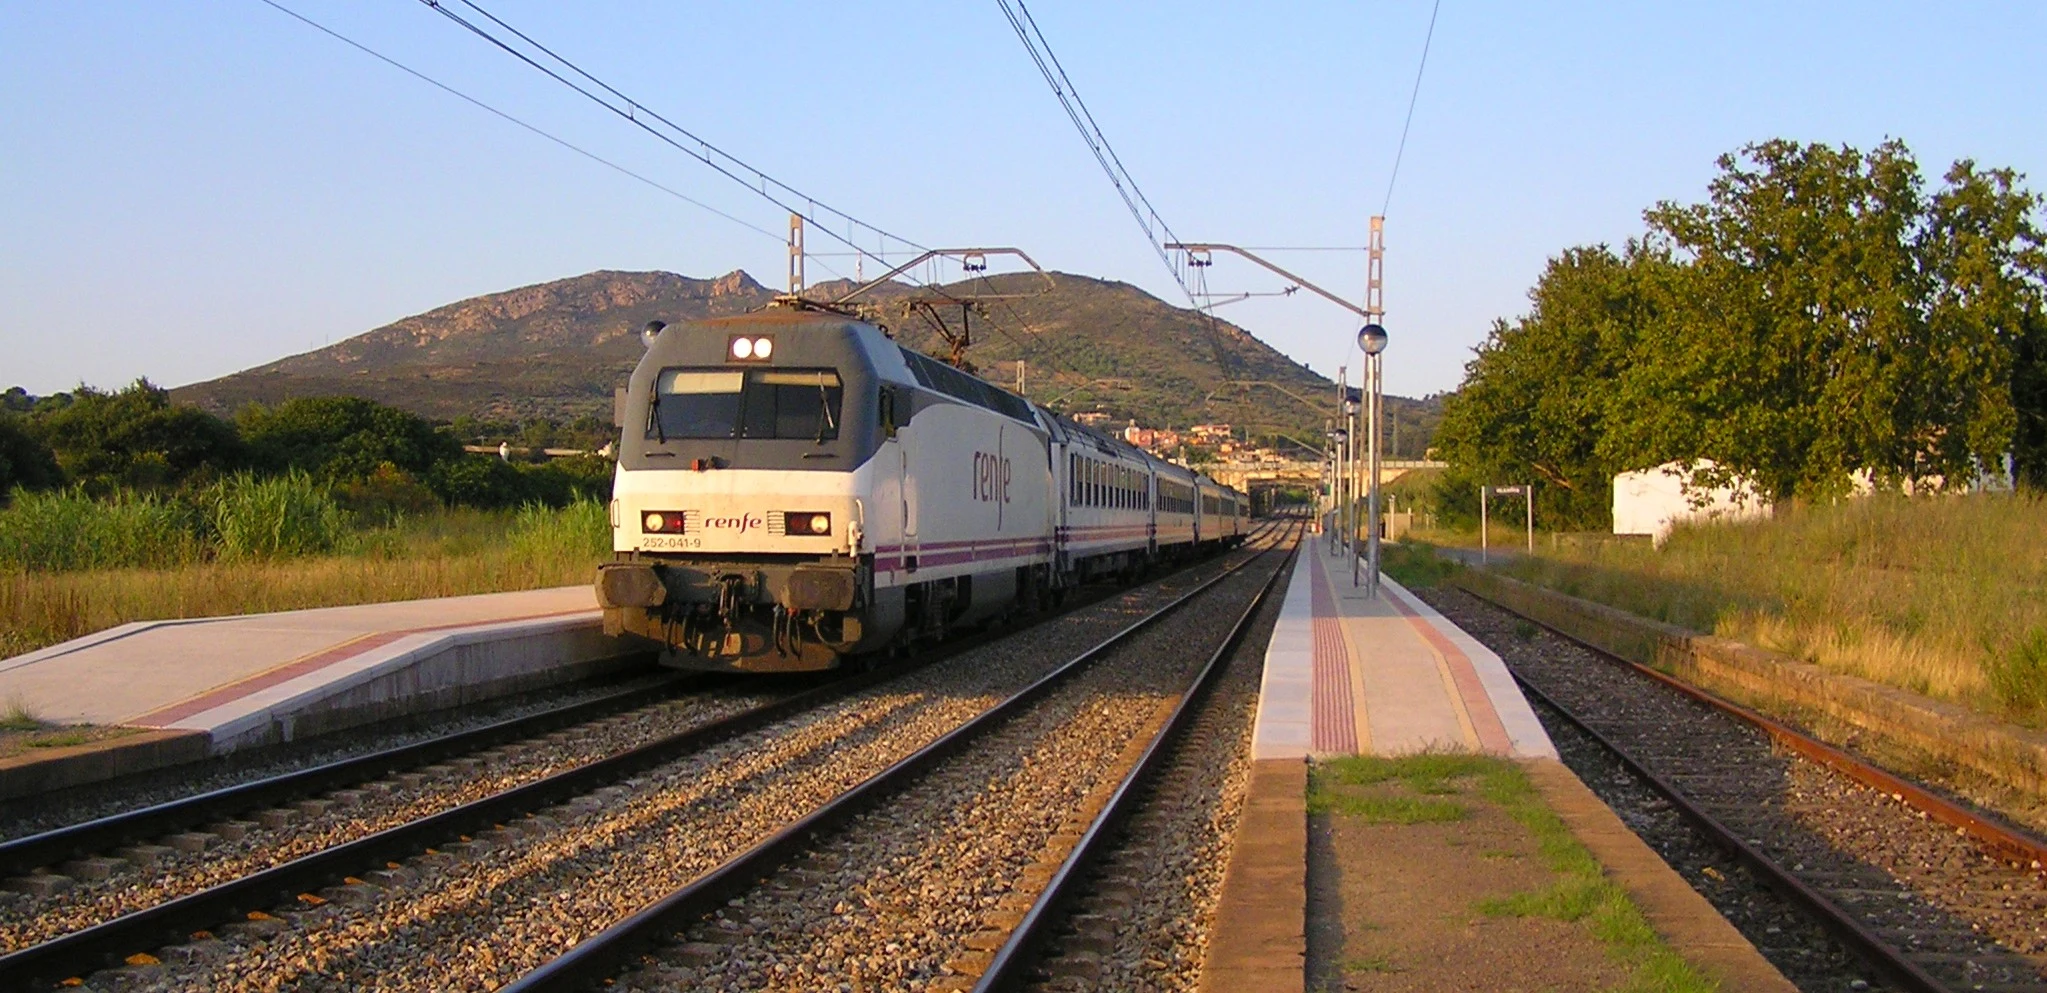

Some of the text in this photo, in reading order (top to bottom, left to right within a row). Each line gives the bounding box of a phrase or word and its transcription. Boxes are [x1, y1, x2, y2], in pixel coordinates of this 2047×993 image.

[973, 425, 1011, 531] renfe
[705, 512, 762, 534] renfe
[643, 537, 701, 548] 252-041-9
